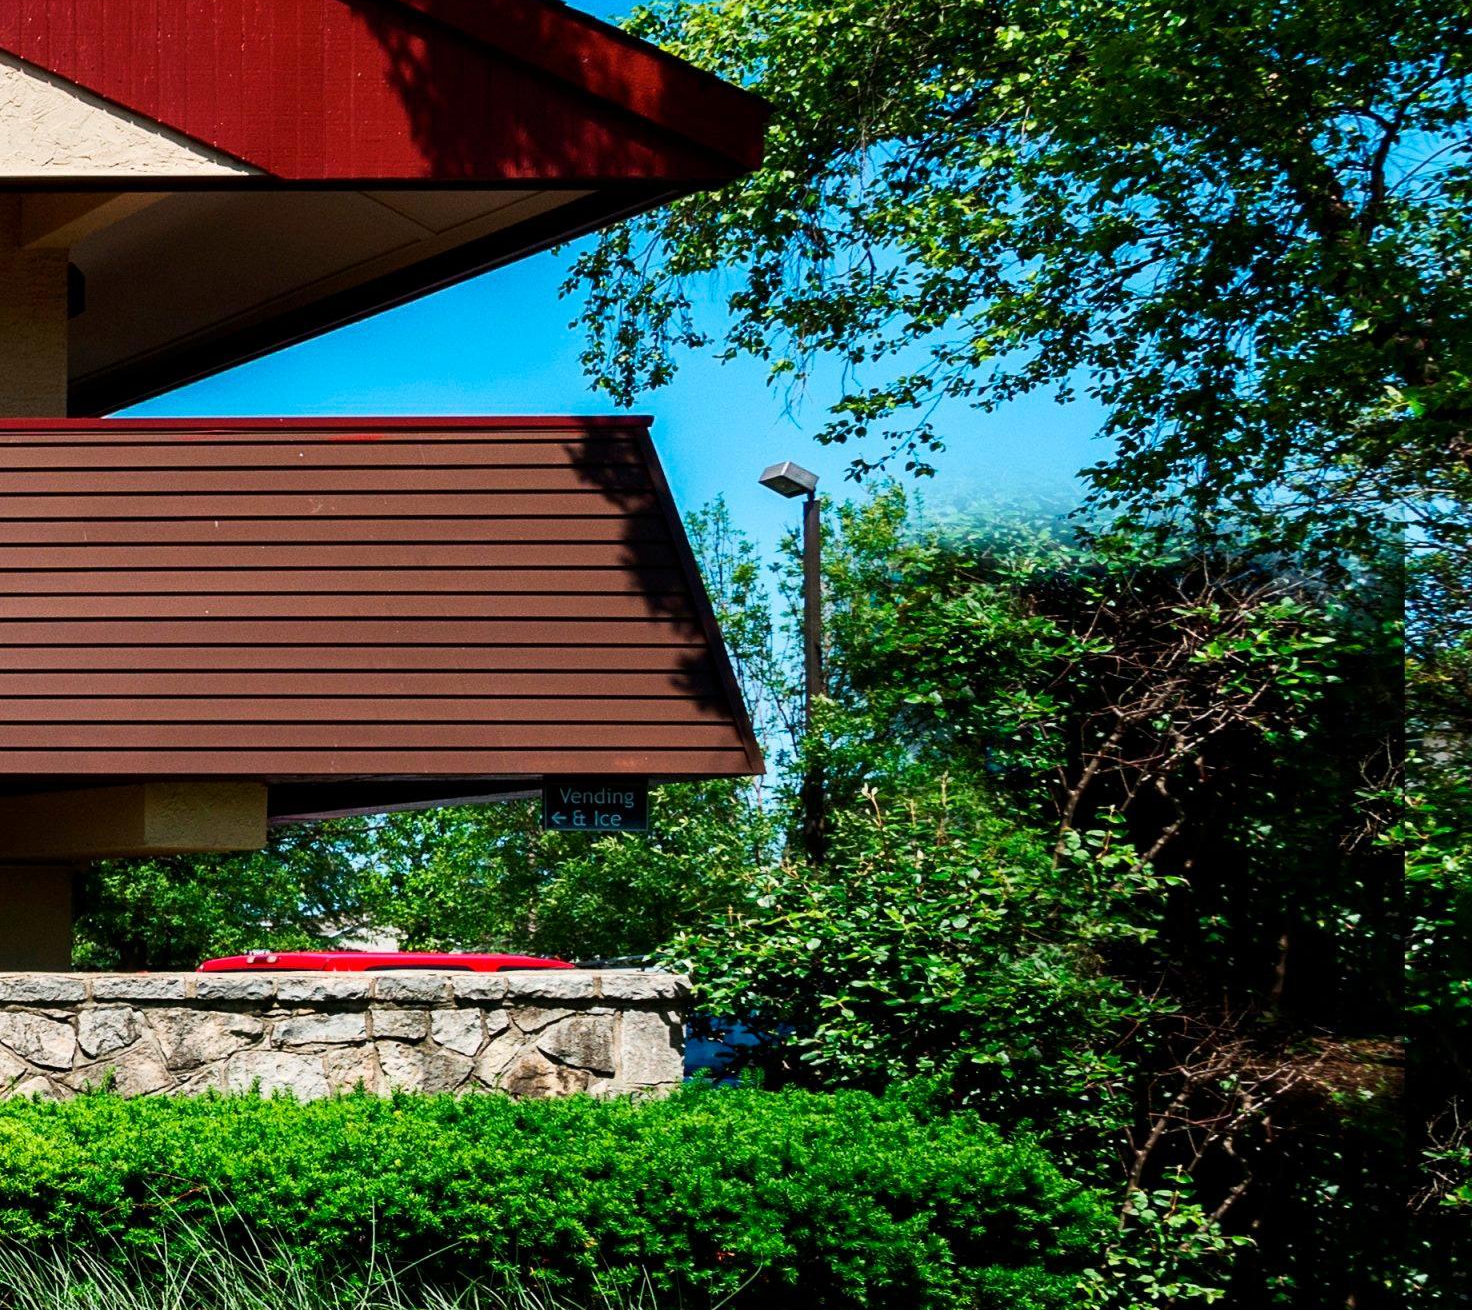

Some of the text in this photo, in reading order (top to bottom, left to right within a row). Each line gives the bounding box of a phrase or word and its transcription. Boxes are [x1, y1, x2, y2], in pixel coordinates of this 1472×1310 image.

[559, 786, 635, 809] Vending
[572, 809, 623, 827] & Ice
